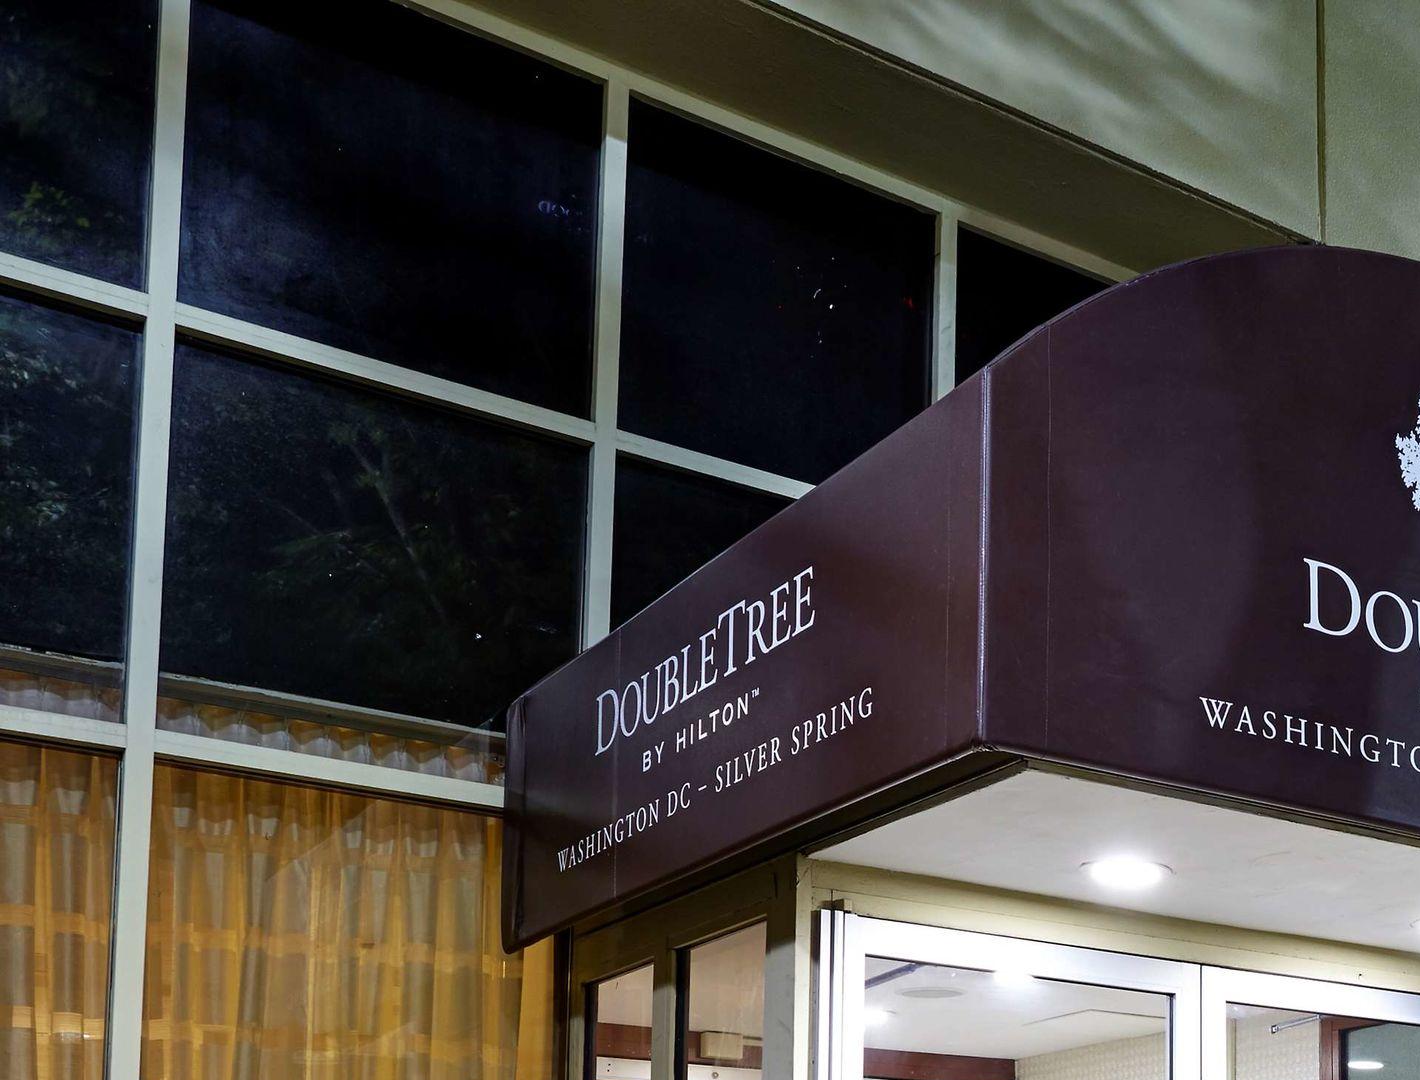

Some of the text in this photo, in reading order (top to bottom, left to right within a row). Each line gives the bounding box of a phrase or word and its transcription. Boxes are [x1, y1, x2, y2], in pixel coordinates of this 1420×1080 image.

[594, 565, 816, 756] DOUBLETREE
[557, 798, 660, 873] WASHINGTON
[666, 782, 691, 817] DC
[714, 736, 782, 793] SILVER
[790, 687, 873, 755] SPRING
[642, 740, 665, 773] BY
